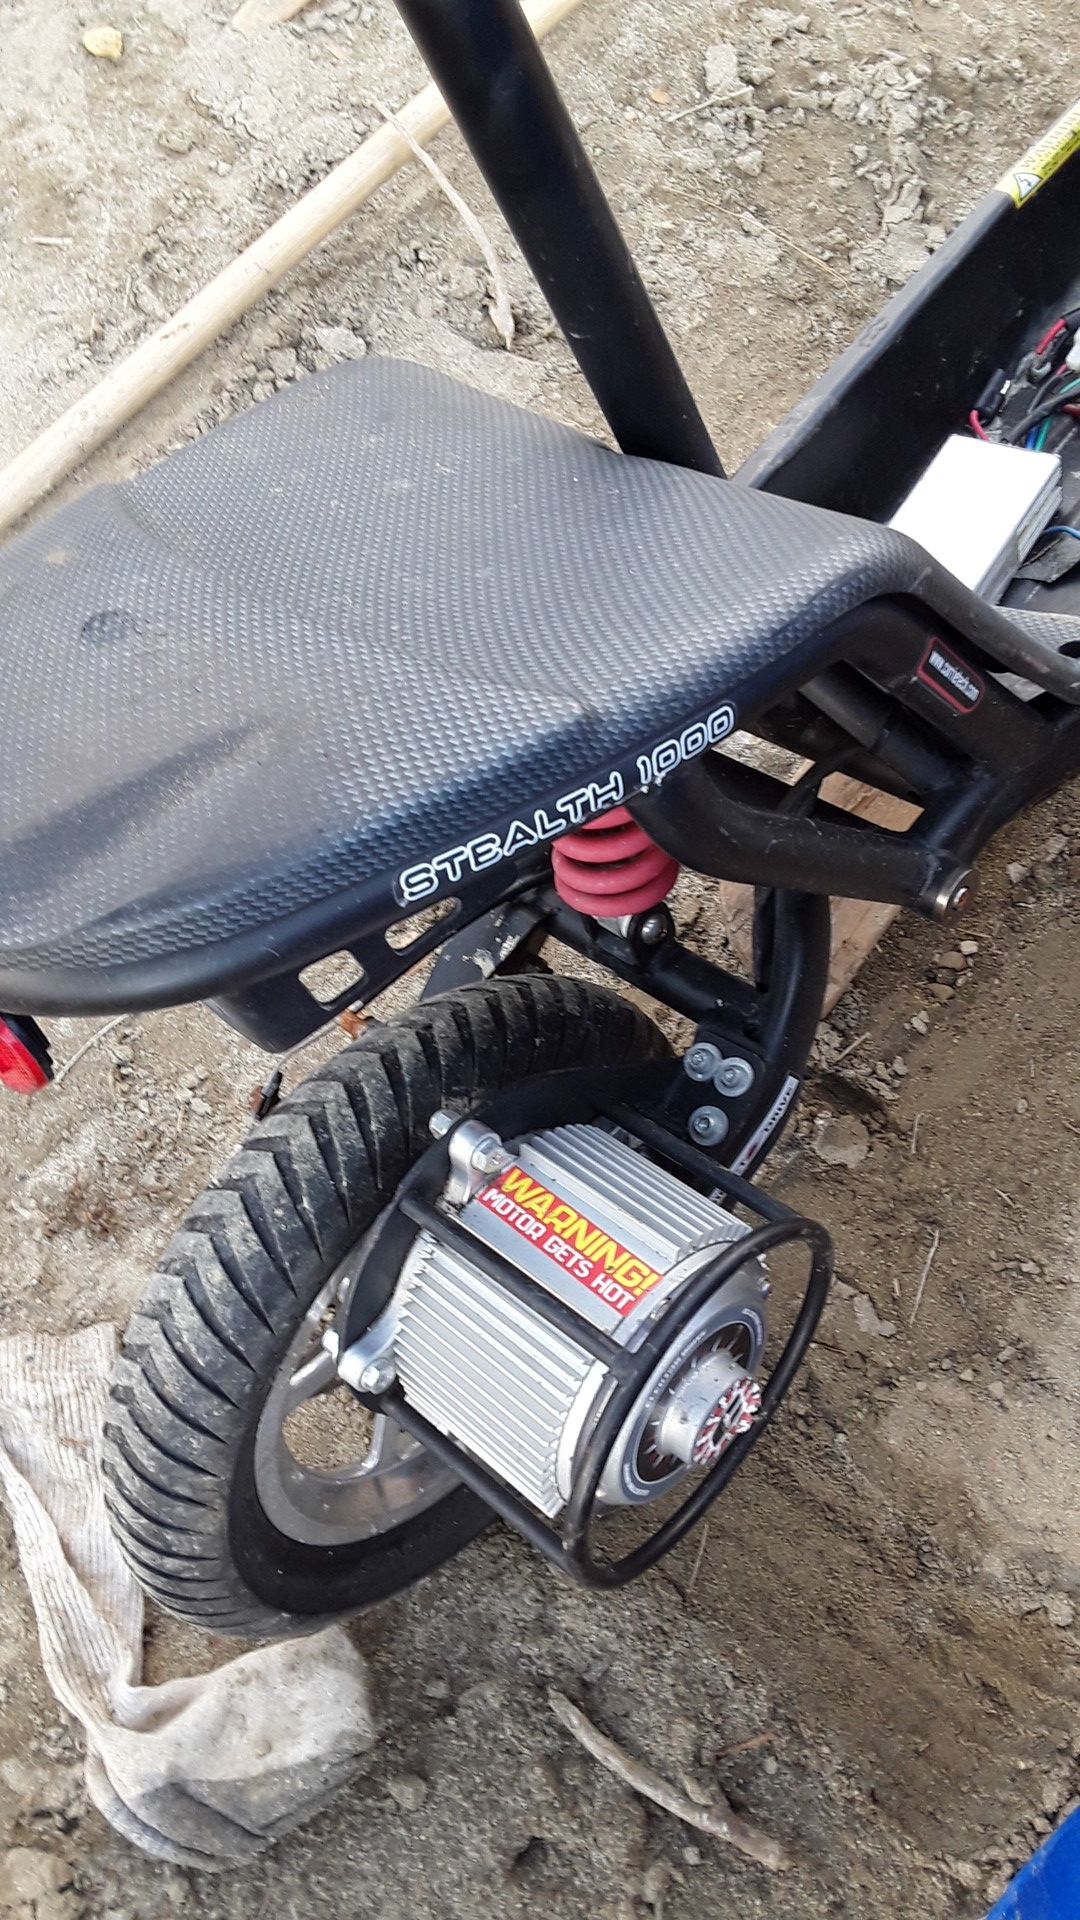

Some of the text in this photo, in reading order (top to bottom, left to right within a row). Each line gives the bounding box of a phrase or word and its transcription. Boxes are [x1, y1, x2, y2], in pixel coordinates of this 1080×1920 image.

[400, 705, 736, 901] STEALTH 1000
[482, 1188, 636, 1310] MOTOR GETS HOT
[502, 1168, 661, 1296] WARNING!
